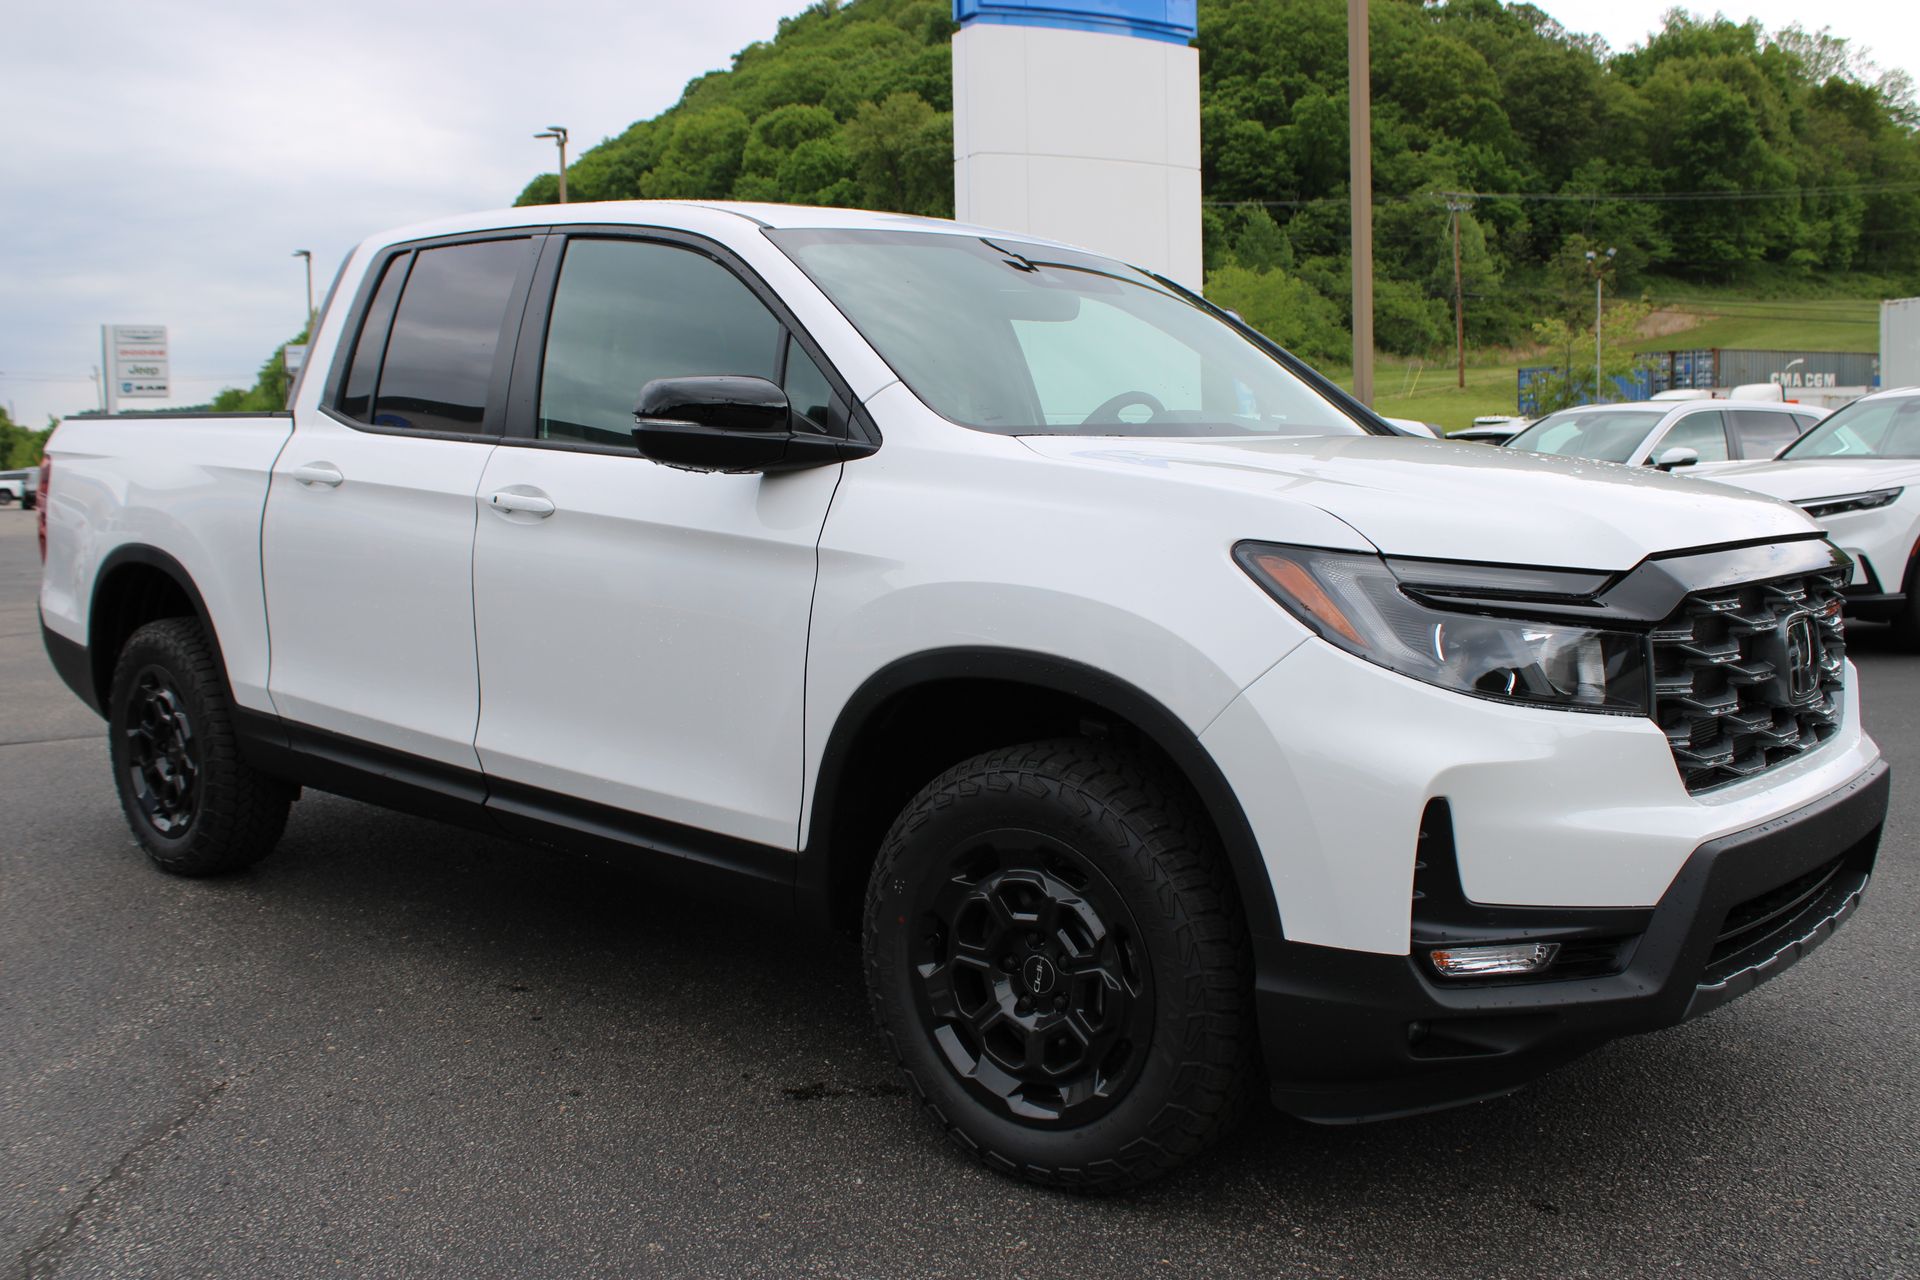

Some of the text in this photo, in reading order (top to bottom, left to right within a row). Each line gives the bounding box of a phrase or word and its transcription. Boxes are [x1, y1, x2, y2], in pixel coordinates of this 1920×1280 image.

[128, 365, 159, 376] Jeep
[1770, 372, 1836, 387] CMA CGM
